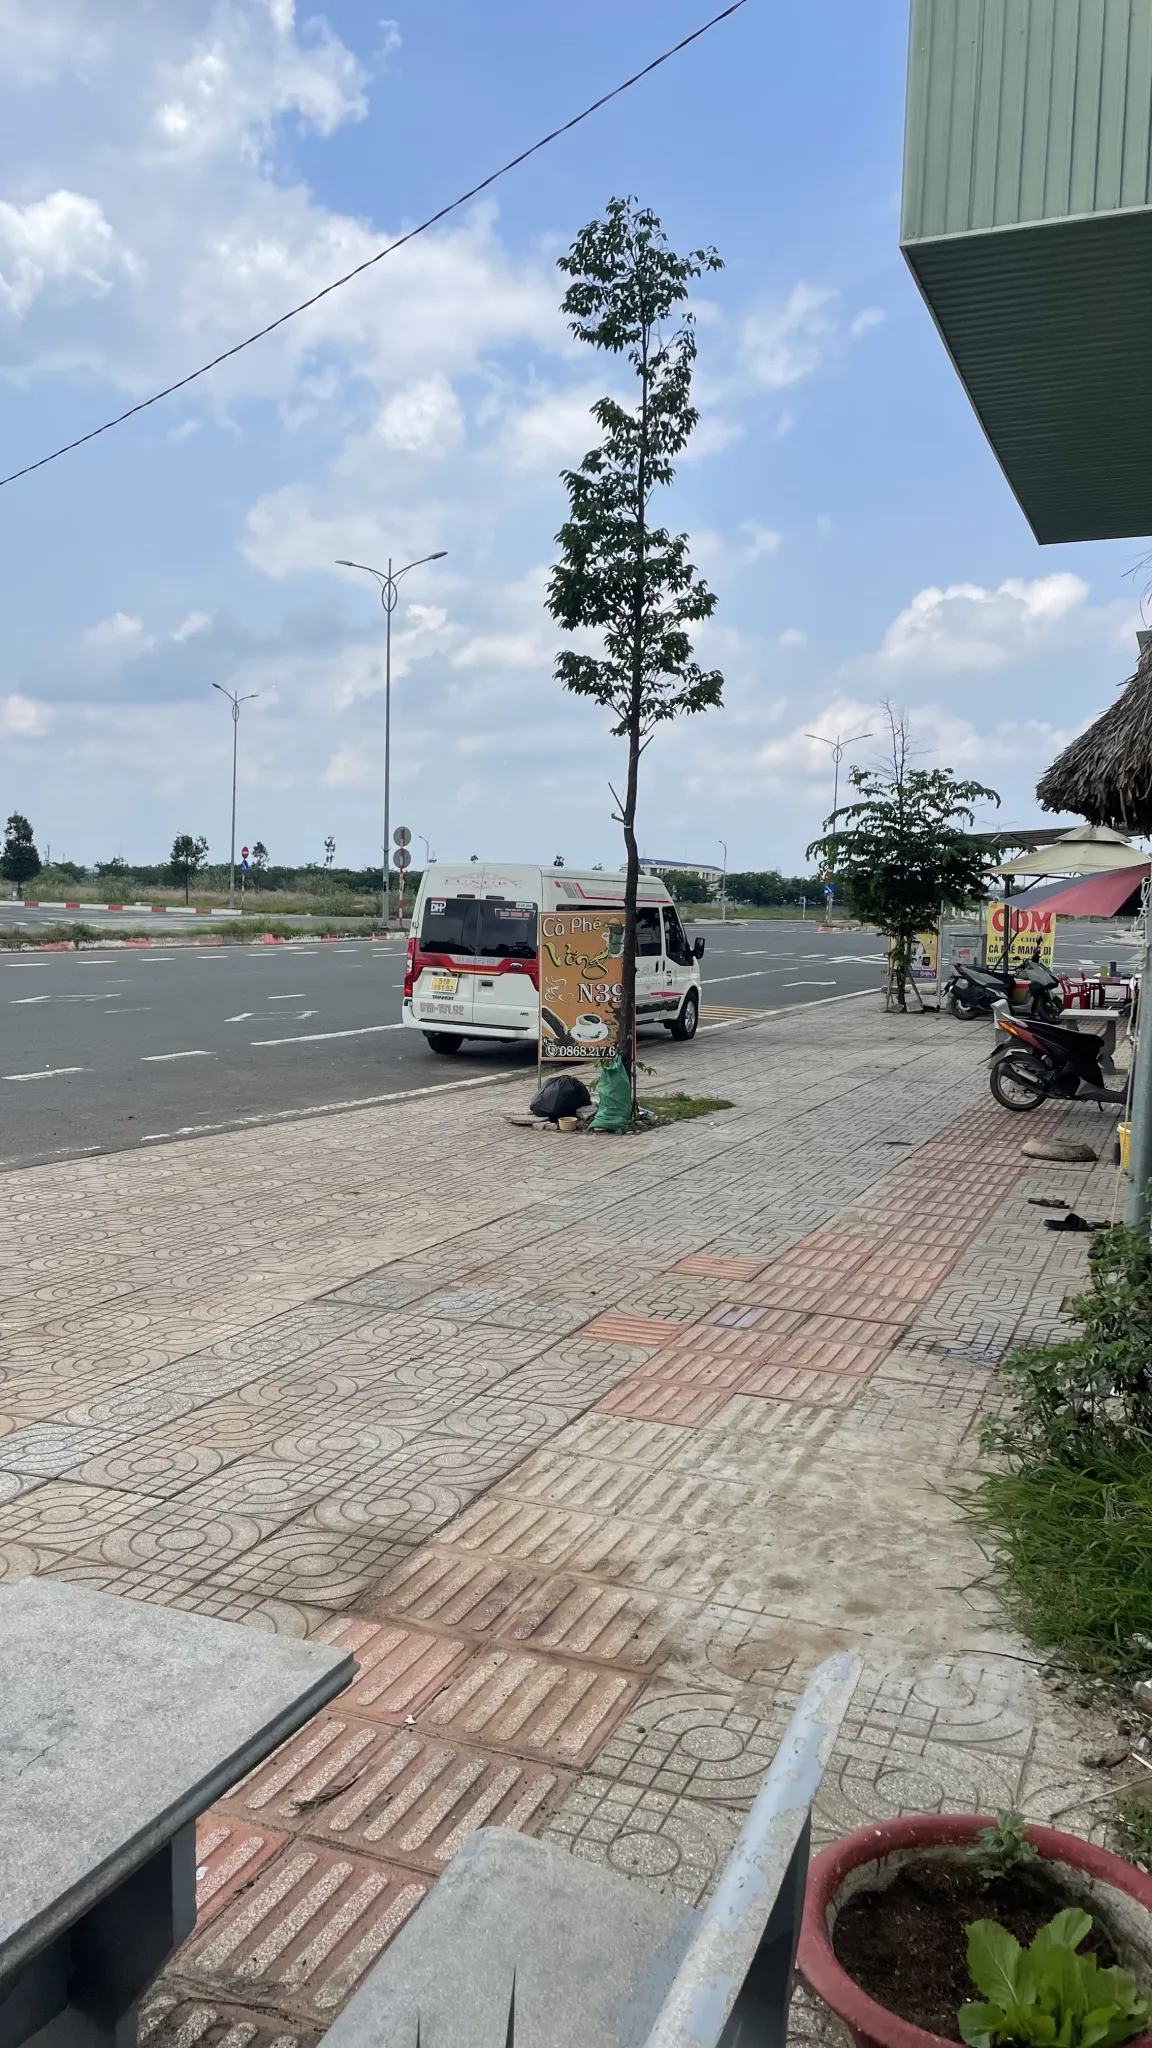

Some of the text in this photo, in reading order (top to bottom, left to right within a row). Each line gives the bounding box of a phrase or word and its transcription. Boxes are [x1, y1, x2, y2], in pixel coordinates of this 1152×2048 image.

[542, 917, 602, 938] Cà Phê
[559, 1045, 616, 1057] 0868.217.6
